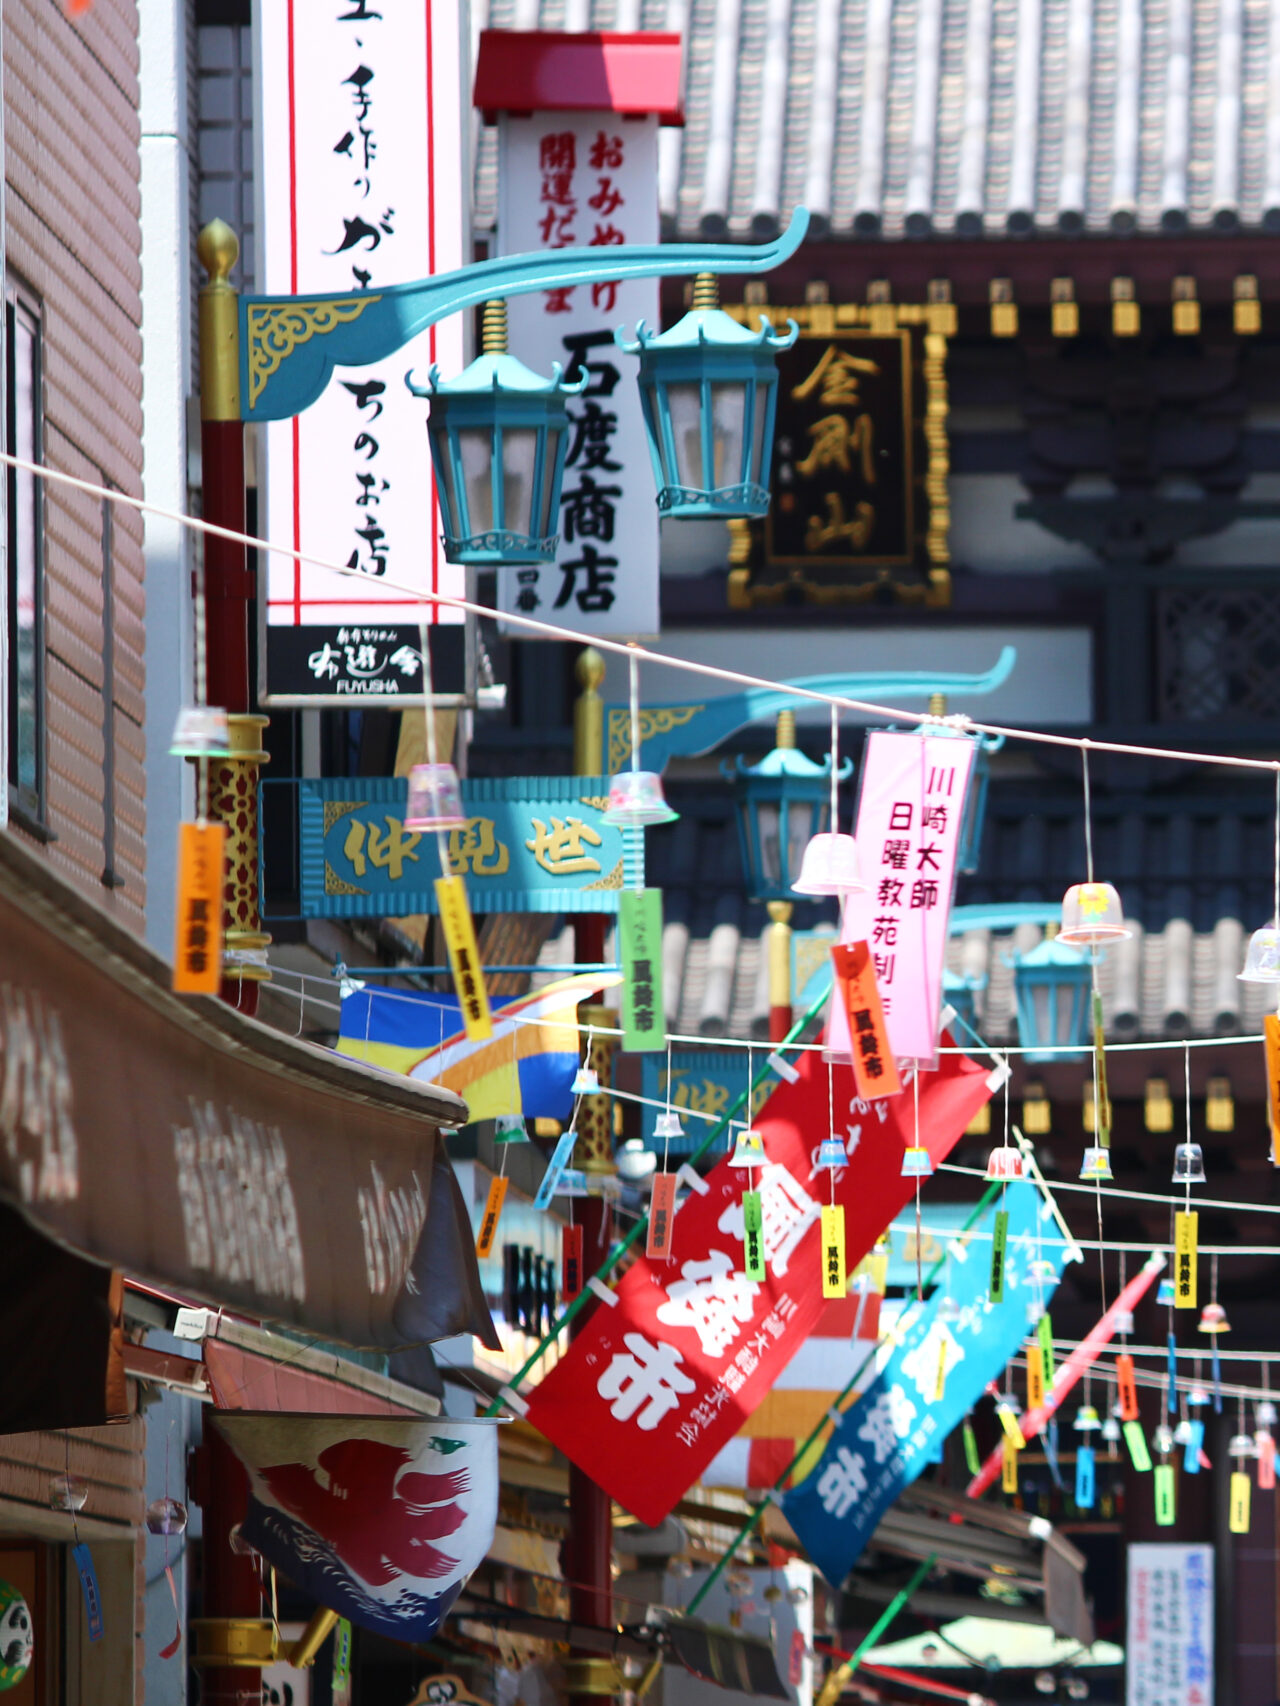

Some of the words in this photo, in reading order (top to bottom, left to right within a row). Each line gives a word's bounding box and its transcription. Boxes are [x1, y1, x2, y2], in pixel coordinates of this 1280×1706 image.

[538, 130, 578, 315] 開運だま
[791, 344, 882, 550] 金剛山
[336, 678, 399, 693] FUYUSHA
[343, 814, 603, 880] 仲見世
[908, 766, 957, 911] 川崎大師
